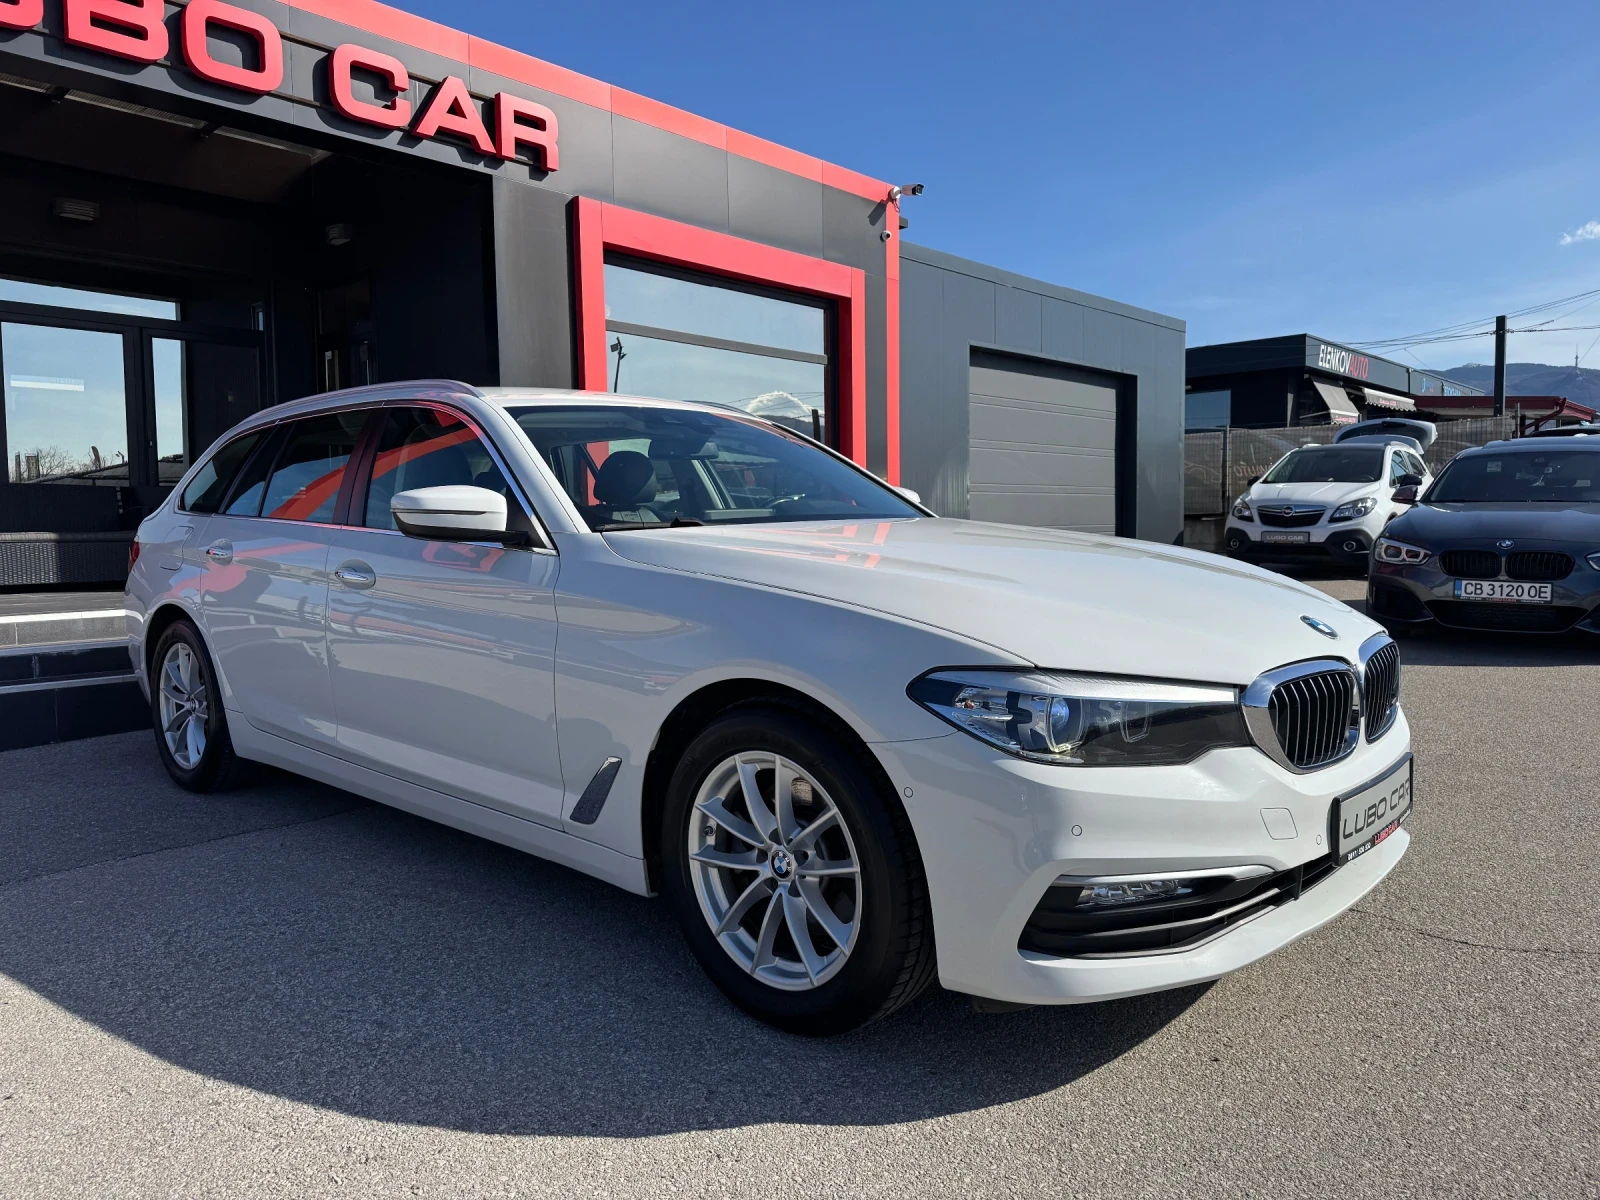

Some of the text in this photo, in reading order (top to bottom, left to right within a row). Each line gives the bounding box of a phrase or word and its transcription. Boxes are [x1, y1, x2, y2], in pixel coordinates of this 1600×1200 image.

[0, 0, 559, 172] BO CAR
[1464, 582, 1484, 596] CB
[1486, 583, 1525, 598] 3120
[1527, 585, 1549, 599] OE
[1343, 797, 1387, 840] LUBO
